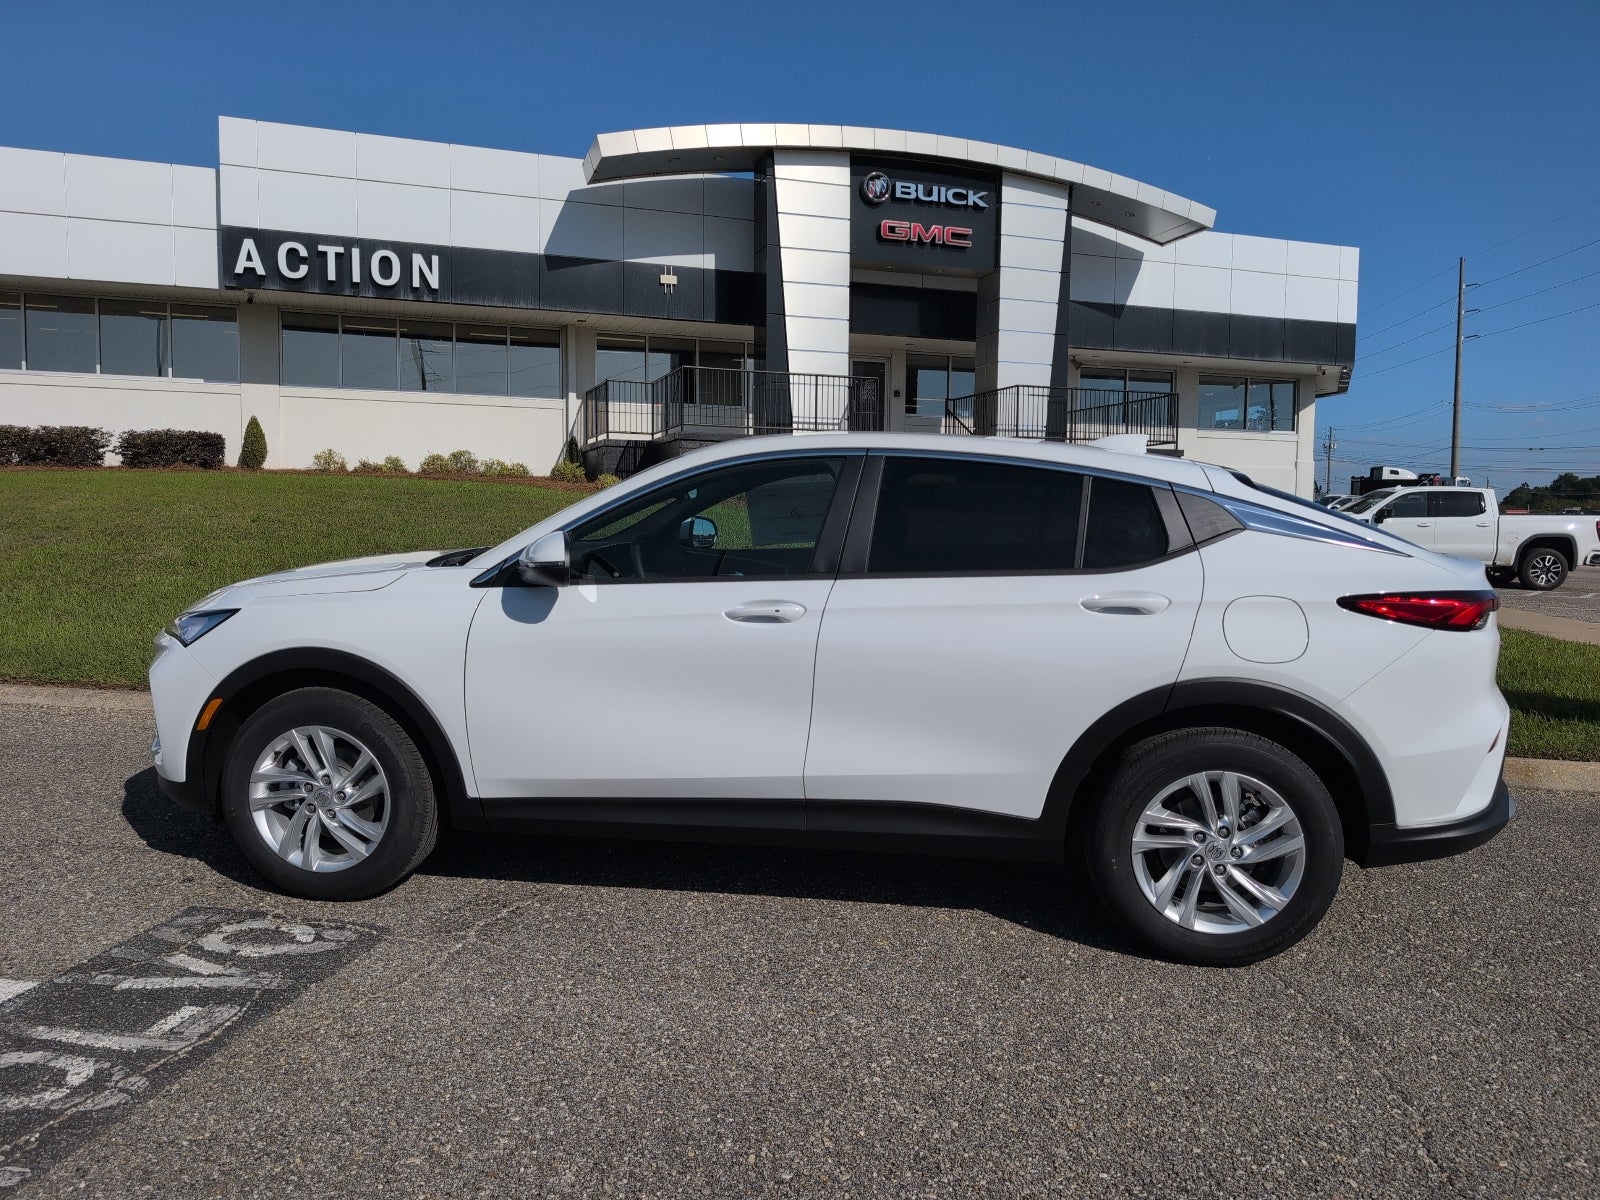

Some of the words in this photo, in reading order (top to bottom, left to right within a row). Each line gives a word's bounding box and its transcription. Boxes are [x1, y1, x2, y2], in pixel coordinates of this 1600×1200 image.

[895, 181, 990, 208] BUICK
[880, 219, 973, 248] GMC
[234, 238, 440, 290] ACTION
